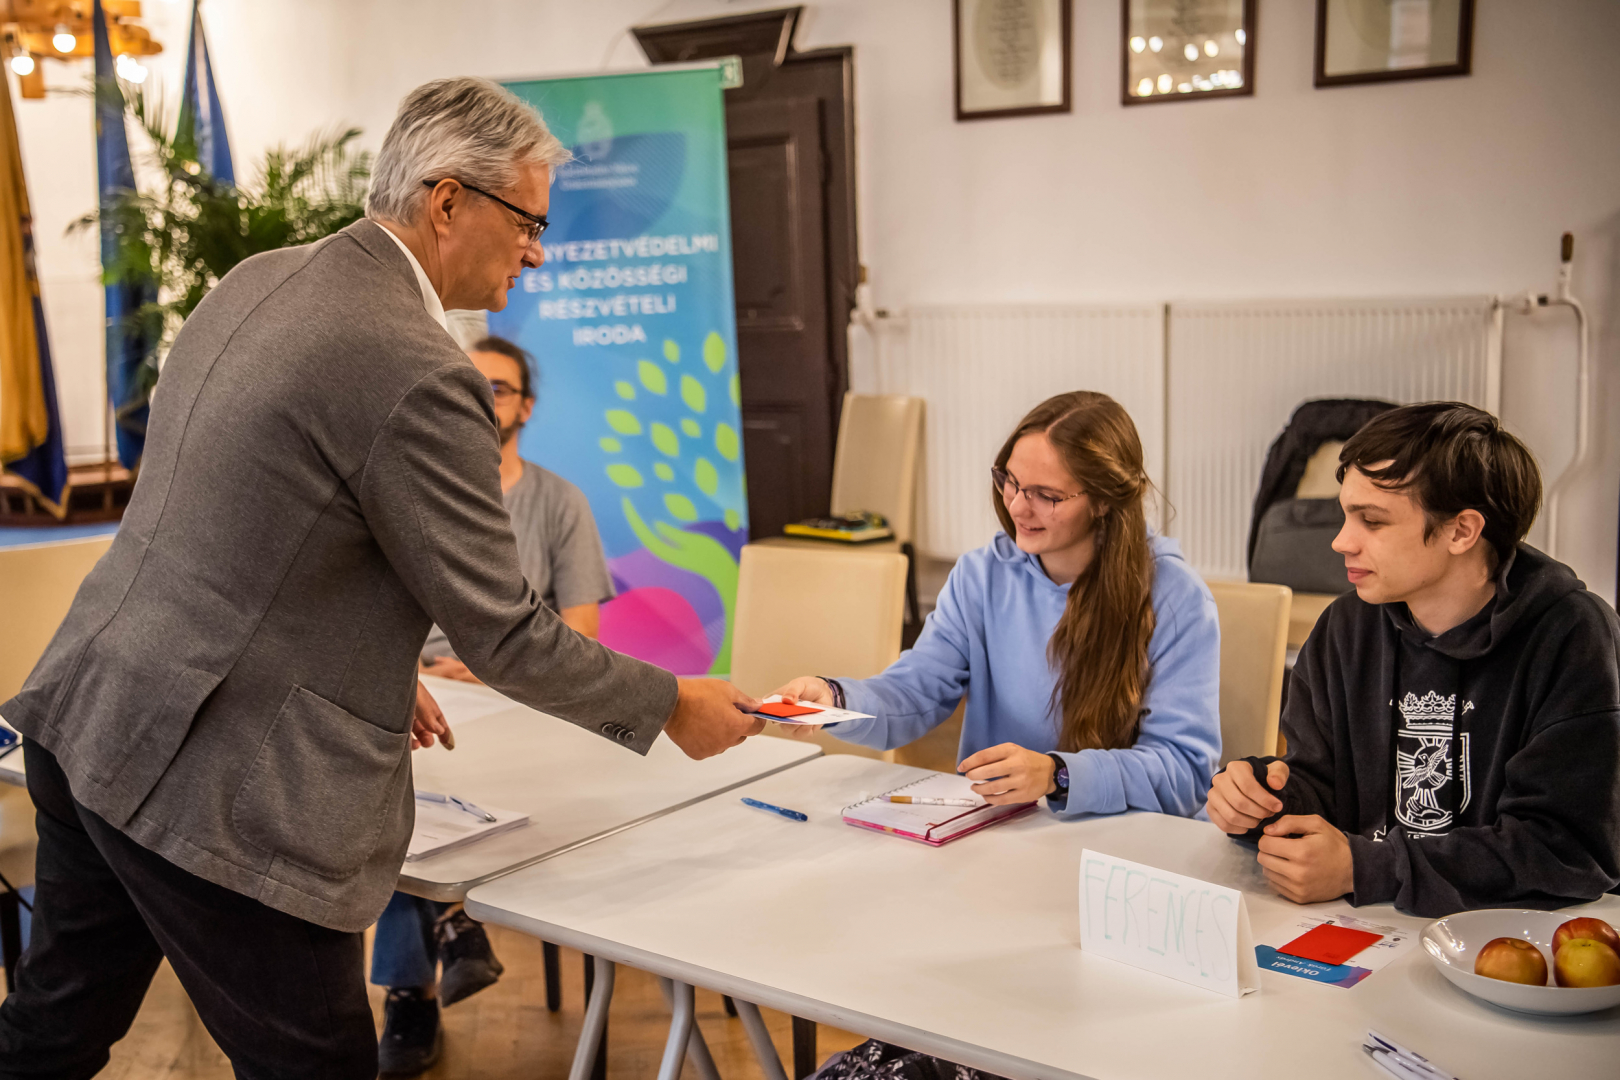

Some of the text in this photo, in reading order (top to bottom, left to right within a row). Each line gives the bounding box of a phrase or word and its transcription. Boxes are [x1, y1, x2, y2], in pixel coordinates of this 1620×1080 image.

[523, 263, 688, 293] ÉS KÖZÖSSÉGI
[539, 293, 676, 319] RÉSZVÉTELI
[1271, 961, 1319, 976] Oklevél
